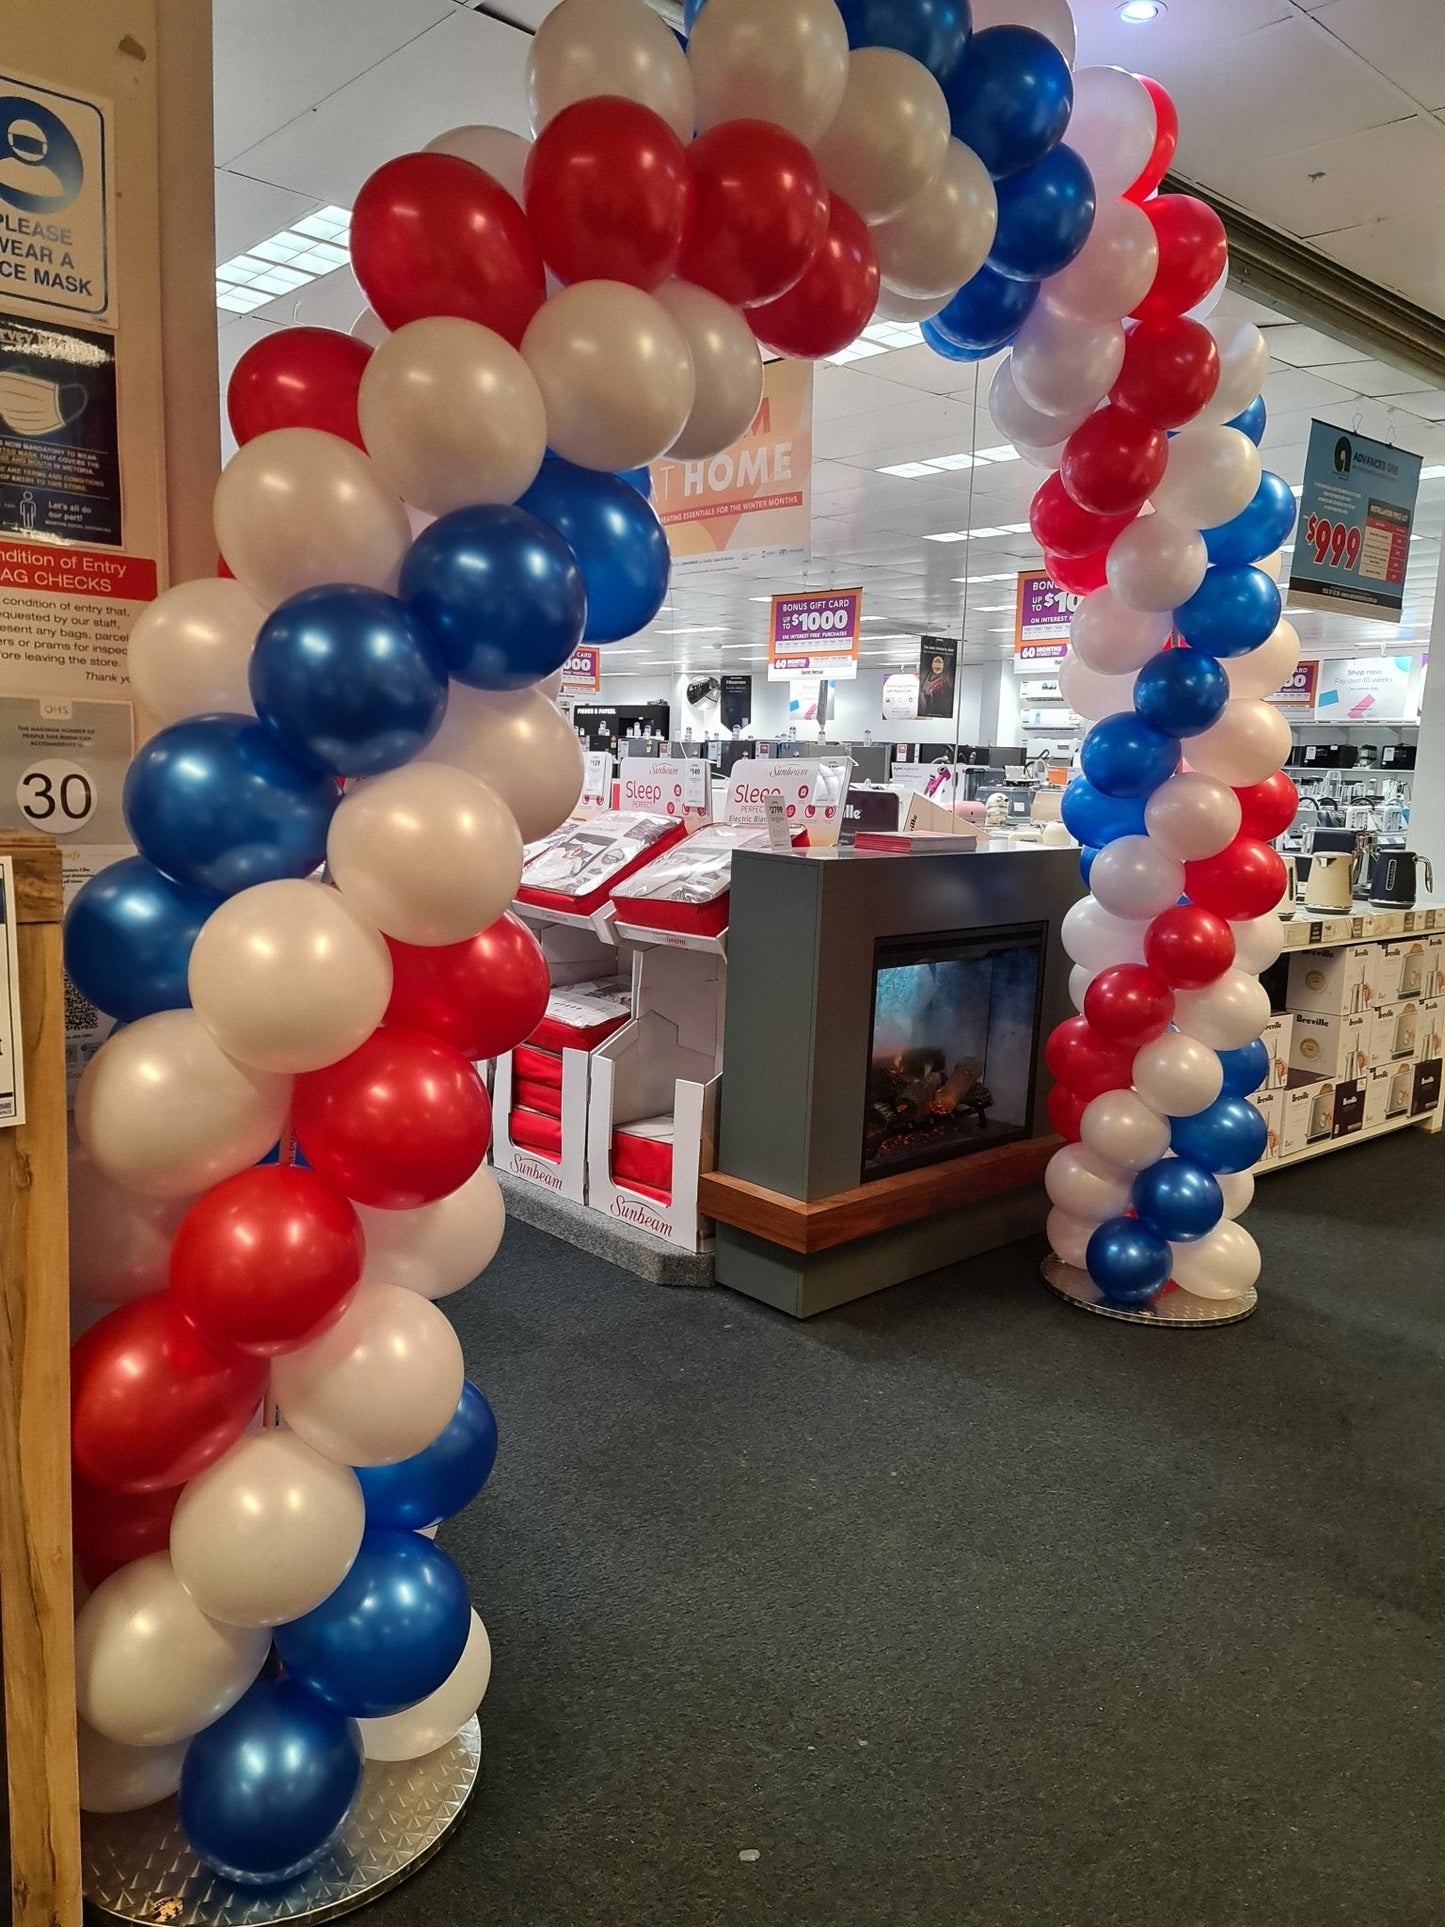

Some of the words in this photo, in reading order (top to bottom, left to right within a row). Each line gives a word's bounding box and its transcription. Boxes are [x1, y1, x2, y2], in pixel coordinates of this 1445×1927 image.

[60, 251, 75, 270] A
[33, 267, 93, 296] MASK
[684, 442, 794, 497] HOME
[48, 500, 68, 510] Let's
[70, 504, 80, 512] all
[683, 507, 716, 520] ESSENTIALS
[716, 504, 728, 514] FOR
[730, 501, 742, 512] THE
[742, 498, 768, 510] WINTER
[768, 494, 798, 506] MONTHS
[1305, 511, 1362, 571] $999
[60, 556, 78, 570] of
[83, 557, 127, 578] Entry
[34, 571, 112, 593] CHECKS
[782, 602, 808, 612] BONUS
[809, 600, 826, 610] GIFT
[828, 598, 850, 608] CARD
[1032, 595, 1042, 604] UP
[3, 597, 56, 610] condition
[59, 602, 70, 610] of
[74, 603, 102, 616] entry
[1032, 603, 1042, 612] TO
[54, 613, 68, 626] by
[71, 617, 90, 626] our
[791, 609, 849, 632] $1000
[1040, 615, 1068, 624] INTEREST
[36, 627, 56, 638] any
[34, 641, 70, 650] prams
[74, 643, 90, 652] for
[1022, 646, 1036, 658] 60
[24, 652, 64, 666] leaving
[69, 656, 86, 666] the
[775, 659, 786, 668] 60
[85, 671, 118, 682] Thank
[1334, 677, 1346, 686] Pay
[649, 762, 680, 776] Sunbeam
[769, 763, 808, 778] Sunbeam
[22, 773, 92, 819] 30
[625, 780, 662, 804] Sleep
[728, 814, 752, 822] Electric
[652, 931, 686, 944] Sunbeam
[1296, 1013, 1328, 1026] Breville
[1377, 1008, 1394, 1018] Breville
[1372, 1069, 1388, 1080] Breville
[1291, 1091, 1308, 1102] Breville
[1342, 1096, 1358, 1106] Breville
[509, 1152, 564, 1190] Sunbeam
[610, 1194, 673, 1237] Sunbeam
